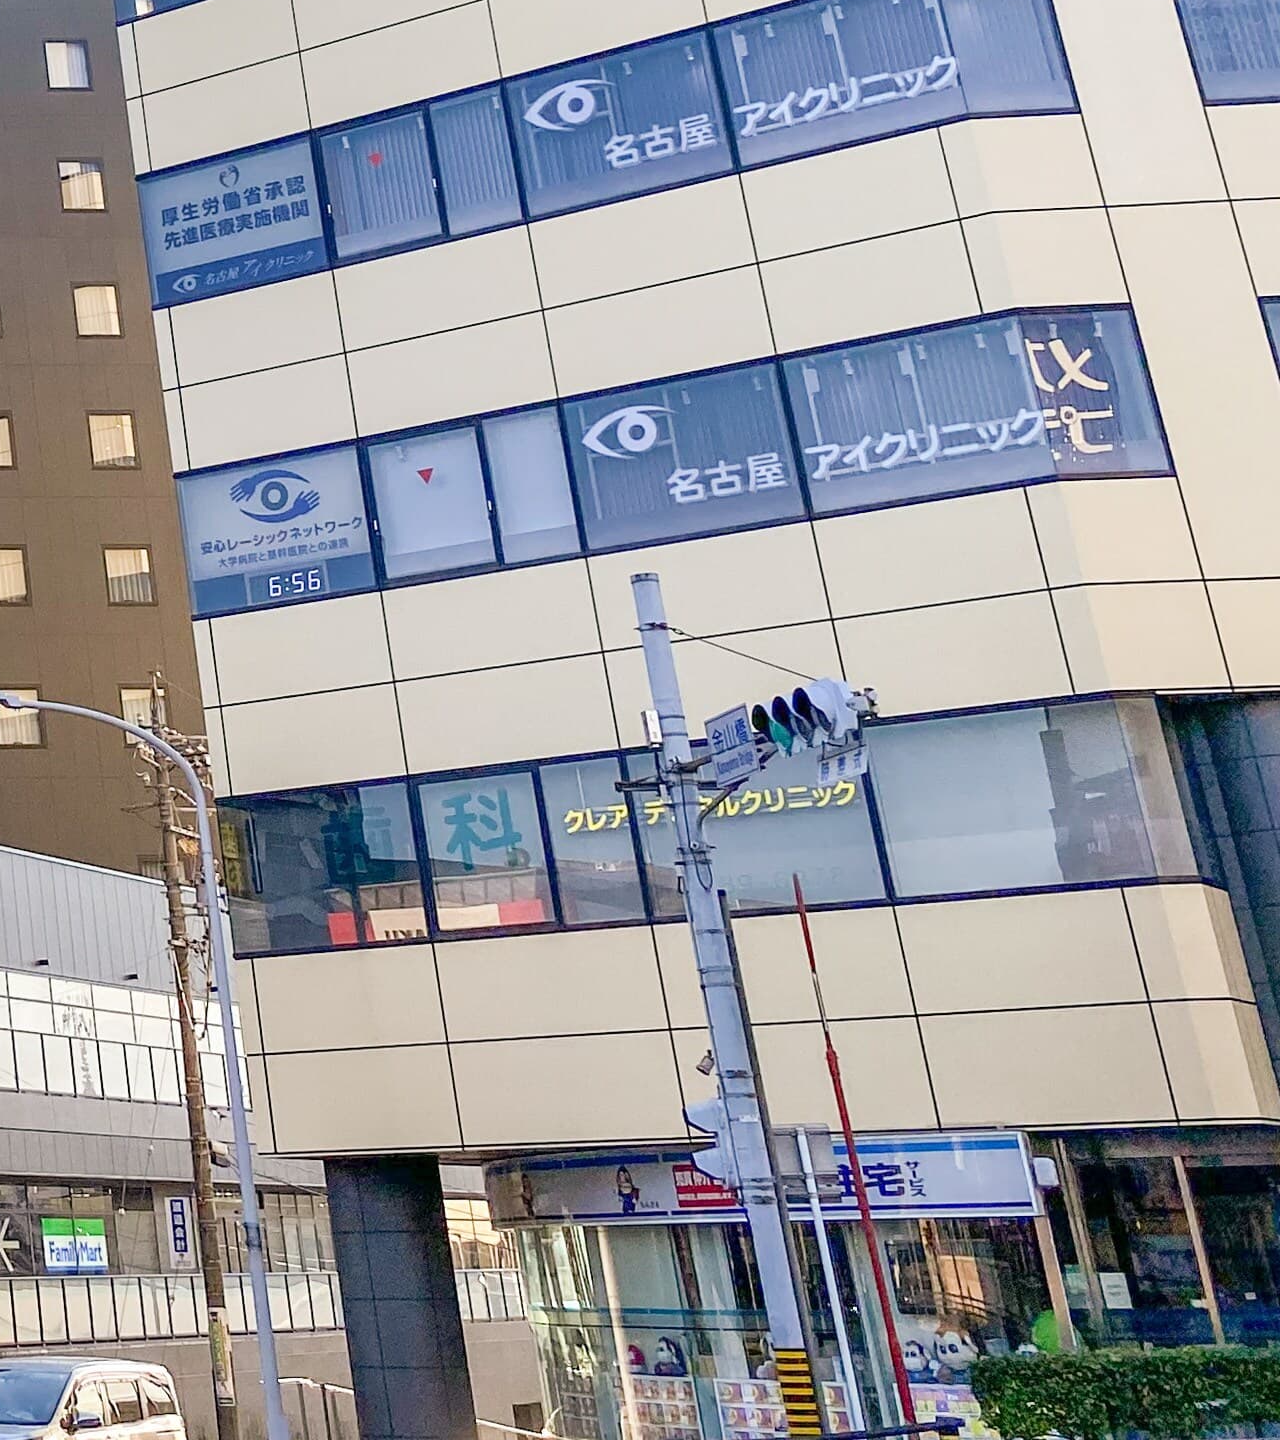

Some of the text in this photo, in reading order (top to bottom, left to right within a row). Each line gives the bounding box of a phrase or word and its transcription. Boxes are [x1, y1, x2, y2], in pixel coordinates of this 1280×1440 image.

[604, 55, 959, 169] 名古屋 アイクリニック
[162, 175, 306, 227] 厚生労働省承認
[164, 199, 311, 251] 先進医療実施機関
[666, 407, 1045, 504] 名古屋 アイクリニック
[269, 570, 321, 597] 6:56
